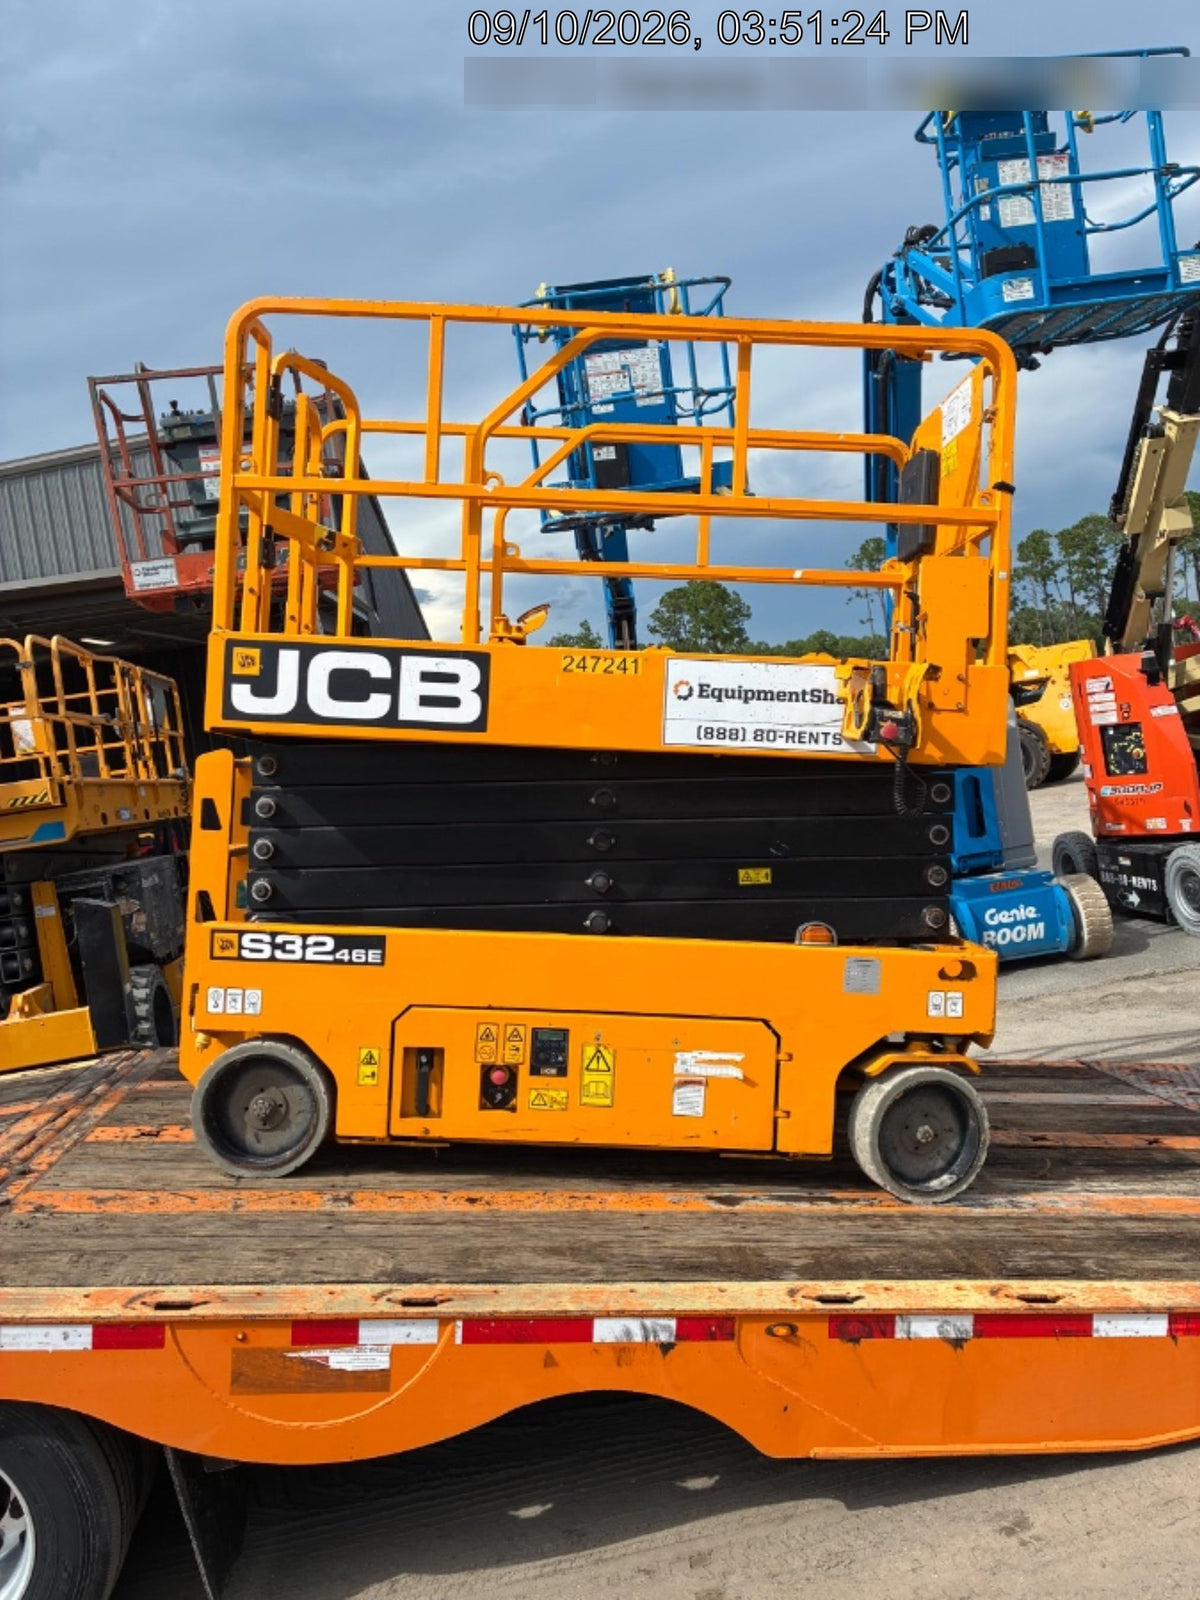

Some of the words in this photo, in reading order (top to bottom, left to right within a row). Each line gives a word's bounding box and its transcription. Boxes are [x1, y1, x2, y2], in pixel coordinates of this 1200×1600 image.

[562, 654, 639, 675] 247241
[231, 649, 482, 724] JCB
[696, 724, 746, 742] (888)
[753, 728, 842, 746] 80-RENTS
[984, 903, 1038, 926] Genie
